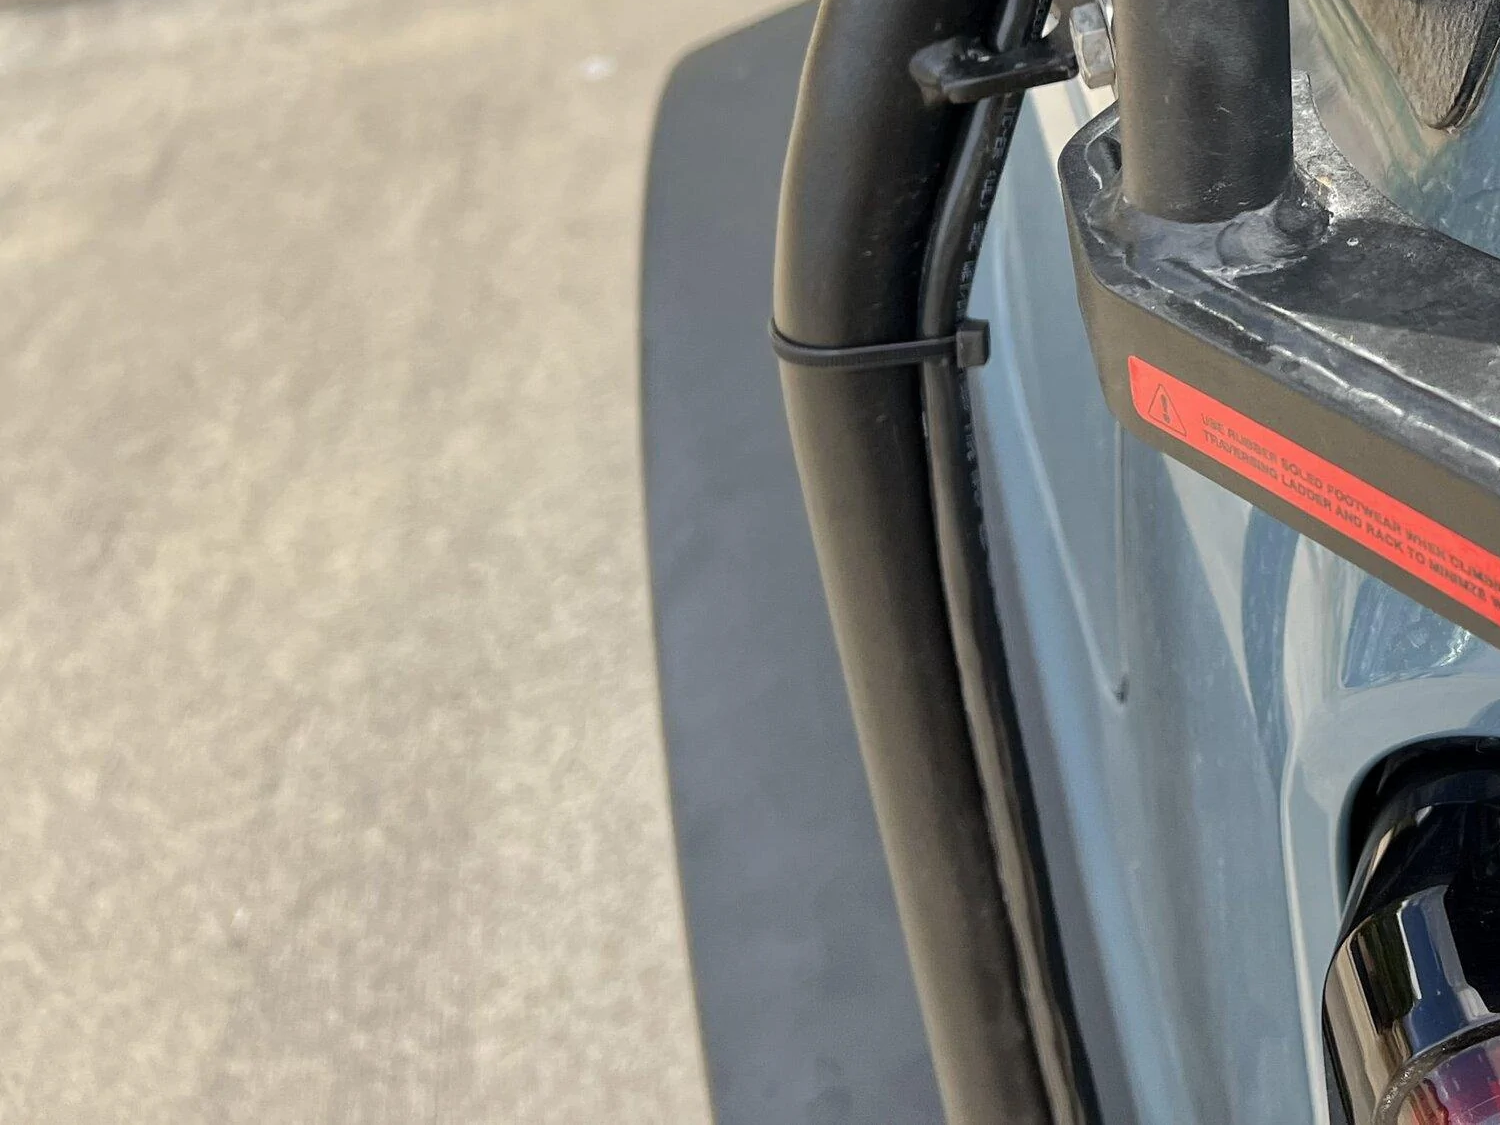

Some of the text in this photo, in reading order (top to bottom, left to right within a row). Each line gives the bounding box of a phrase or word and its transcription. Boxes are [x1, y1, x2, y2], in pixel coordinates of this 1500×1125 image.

[1200, 413, 1225, 435] USE
[1227, 428, 1278, 464] RUBBER
[1280, 457, 1323, 489] SOLED
[1327, 484, 1402, 535] FOOTWEAR
[1406, 528, 1446, 560] WHEN
[1202, 429, 1278, 480] TRAVERSING
[1281, 474, 1332, 512] LADDER
[1335, 505, 1362, 529] AND
[1366, 522, 1404, 554] RACK
[1407, 545, 1426, 565] TO
[1428, 557, 1487, 602] MINIMIZE
